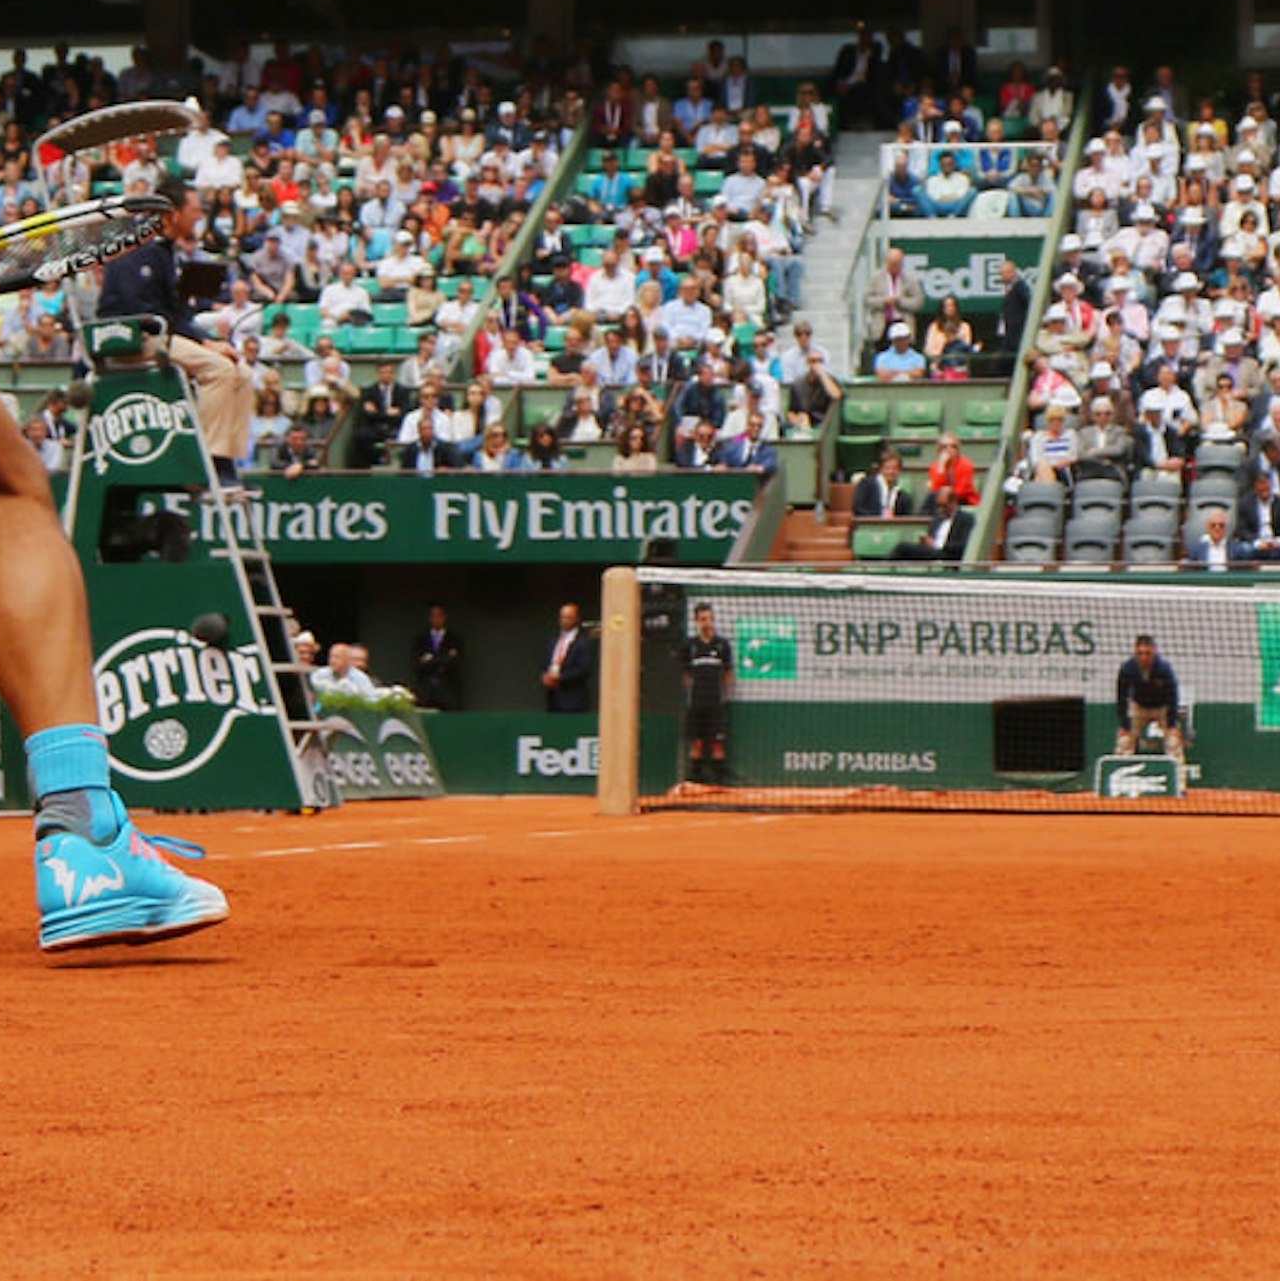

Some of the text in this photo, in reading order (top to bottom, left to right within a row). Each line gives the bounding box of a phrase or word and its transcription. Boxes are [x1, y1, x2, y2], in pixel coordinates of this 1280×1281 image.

[432, 485, 753, 550] Fly Emirates
[814, 620, 1096, 657] BNP PARIBAS
[784, 751, 938, 773] BNP PARIBAS
